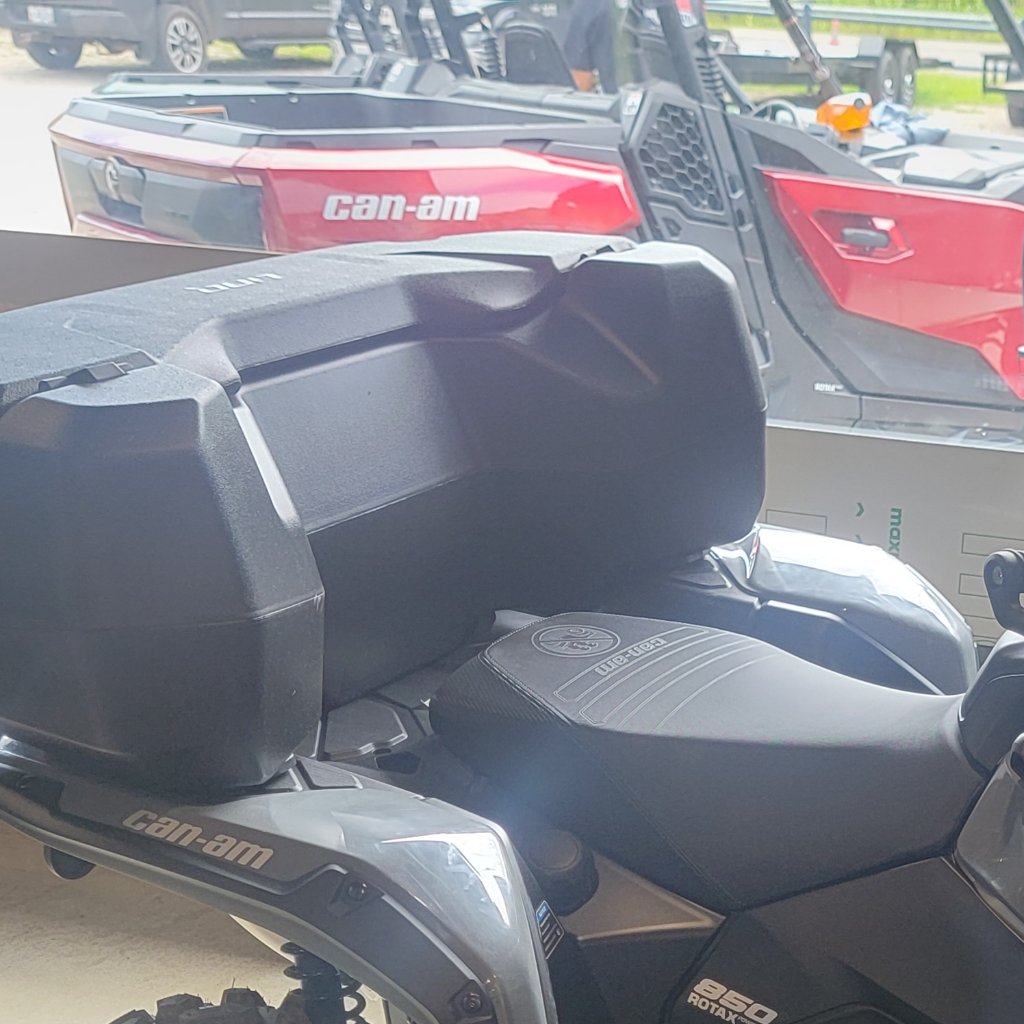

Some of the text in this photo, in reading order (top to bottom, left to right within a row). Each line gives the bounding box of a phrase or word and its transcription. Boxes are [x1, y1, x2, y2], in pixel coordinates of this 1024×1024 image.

[322, 194, 481, 221] can-am
[889, 507, 902, 556] max
[595, 637, 668, 676] can-am
[122, 809, 274, 870] can-am
[687, 992, 738, 1024] ROTAX
[693, 978, 778, 1024] 850
